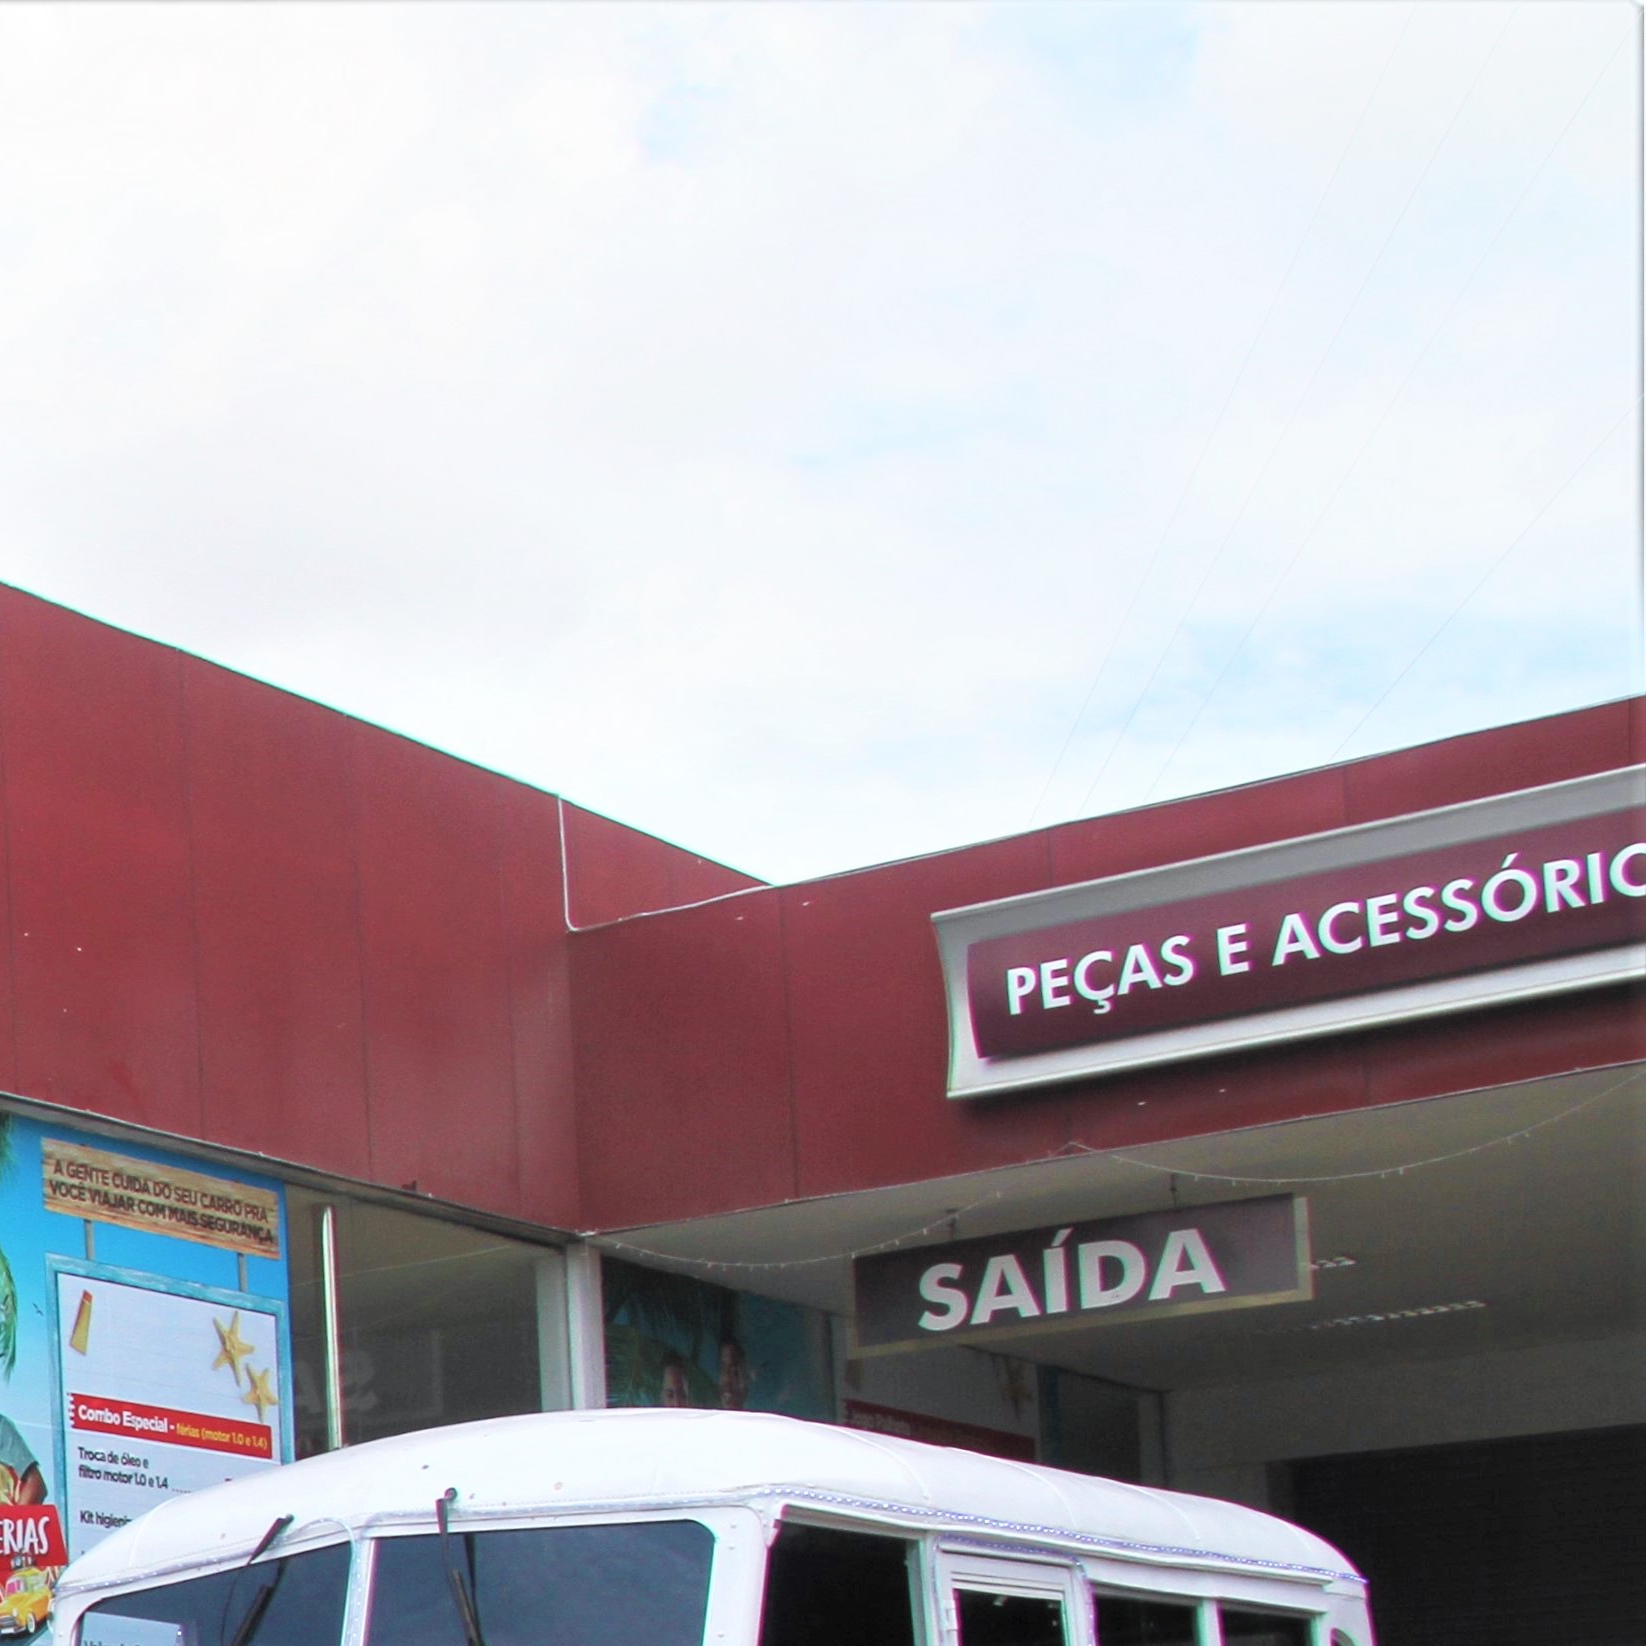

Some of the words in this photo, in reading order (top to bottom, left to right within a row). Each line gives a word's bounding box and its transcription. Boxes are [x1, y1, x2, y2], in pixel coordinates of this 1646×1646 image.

[1006, 934, 1196, 1016] PEÇAS
[1217, 924, 1252, 976] E
[49, 1180, 86, 1202] VOCÊ
[89, 1188, 135, 1212] VIAJAR
[137, 1199, 168, 1220] COM
[169, 1205, 198, 1226] MAIS
[198, 1212, 273, 1245] SEGURANÇA
[53, 1158, 64, 1176] A
[66, 1161, 110, 1187] GENTE
[112, 1171, 151, 1194] CUIDA
[153, 1180, 172, 1199] DO
[175, 1186, 198, 1205] SEU
[200, 1192, 243, 1216] CARRO
[244, 1203, 269, 1223] PRA
[918, 1228, 1227, 1334] SAÍDA
[78, 1404, 121, 1425] Combo
[122, 1411, 169, 1434] Especial
[202, 1426, 230, 1444] (motor
[245, 1436, 251, 1446] e
[78, 1446, 106, 1462] Troca
[108, 1450, 119, 1464] de
[121, 1452, 141, 1468] óleo
[143, 1458, 149, 1469] e
[78, 1464, 102, 1480] filtro
[103, 1469, 133, 1485] motor
[134, 1472, 146, 1486] 1.0
[148, 1478, 154, 1488] e
[156, 1476, 169, 1490] 1.4
[80, 1510, 94, 1524] Kit
